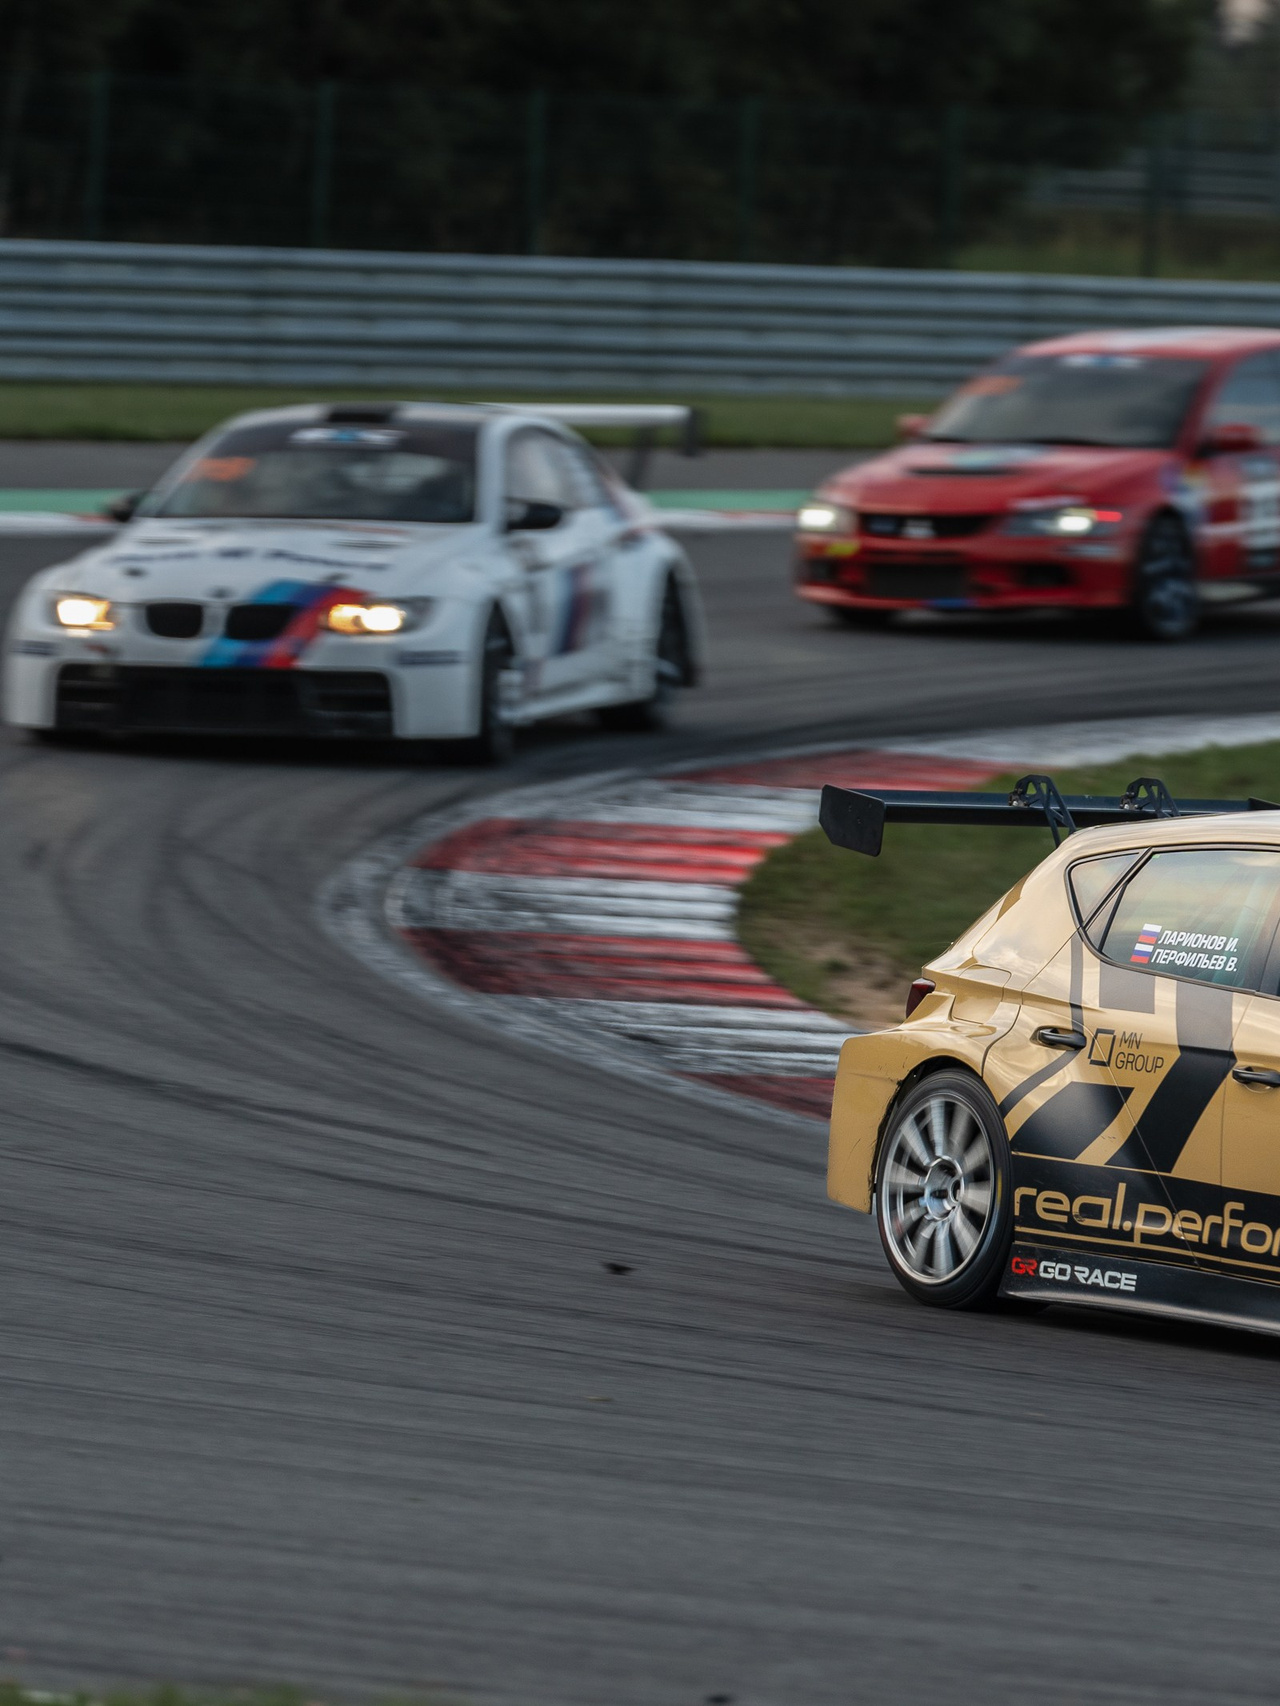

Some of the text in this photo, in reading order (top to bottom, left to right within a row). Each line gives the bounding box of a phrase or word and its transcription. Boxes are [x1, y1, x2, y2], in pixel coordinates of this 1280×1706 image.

[1158, 930, 1239, 952] ЛАРИОНОВ И.
[1151, 949, 1238, 972] ПЕРФИЛЬЕВ В.
[1119, 1031, 1143, 1049] MN
[1115, 1051, 1164, 1073] GROUP
[1011, 1257, 1138, 1292] GR GO RACE
